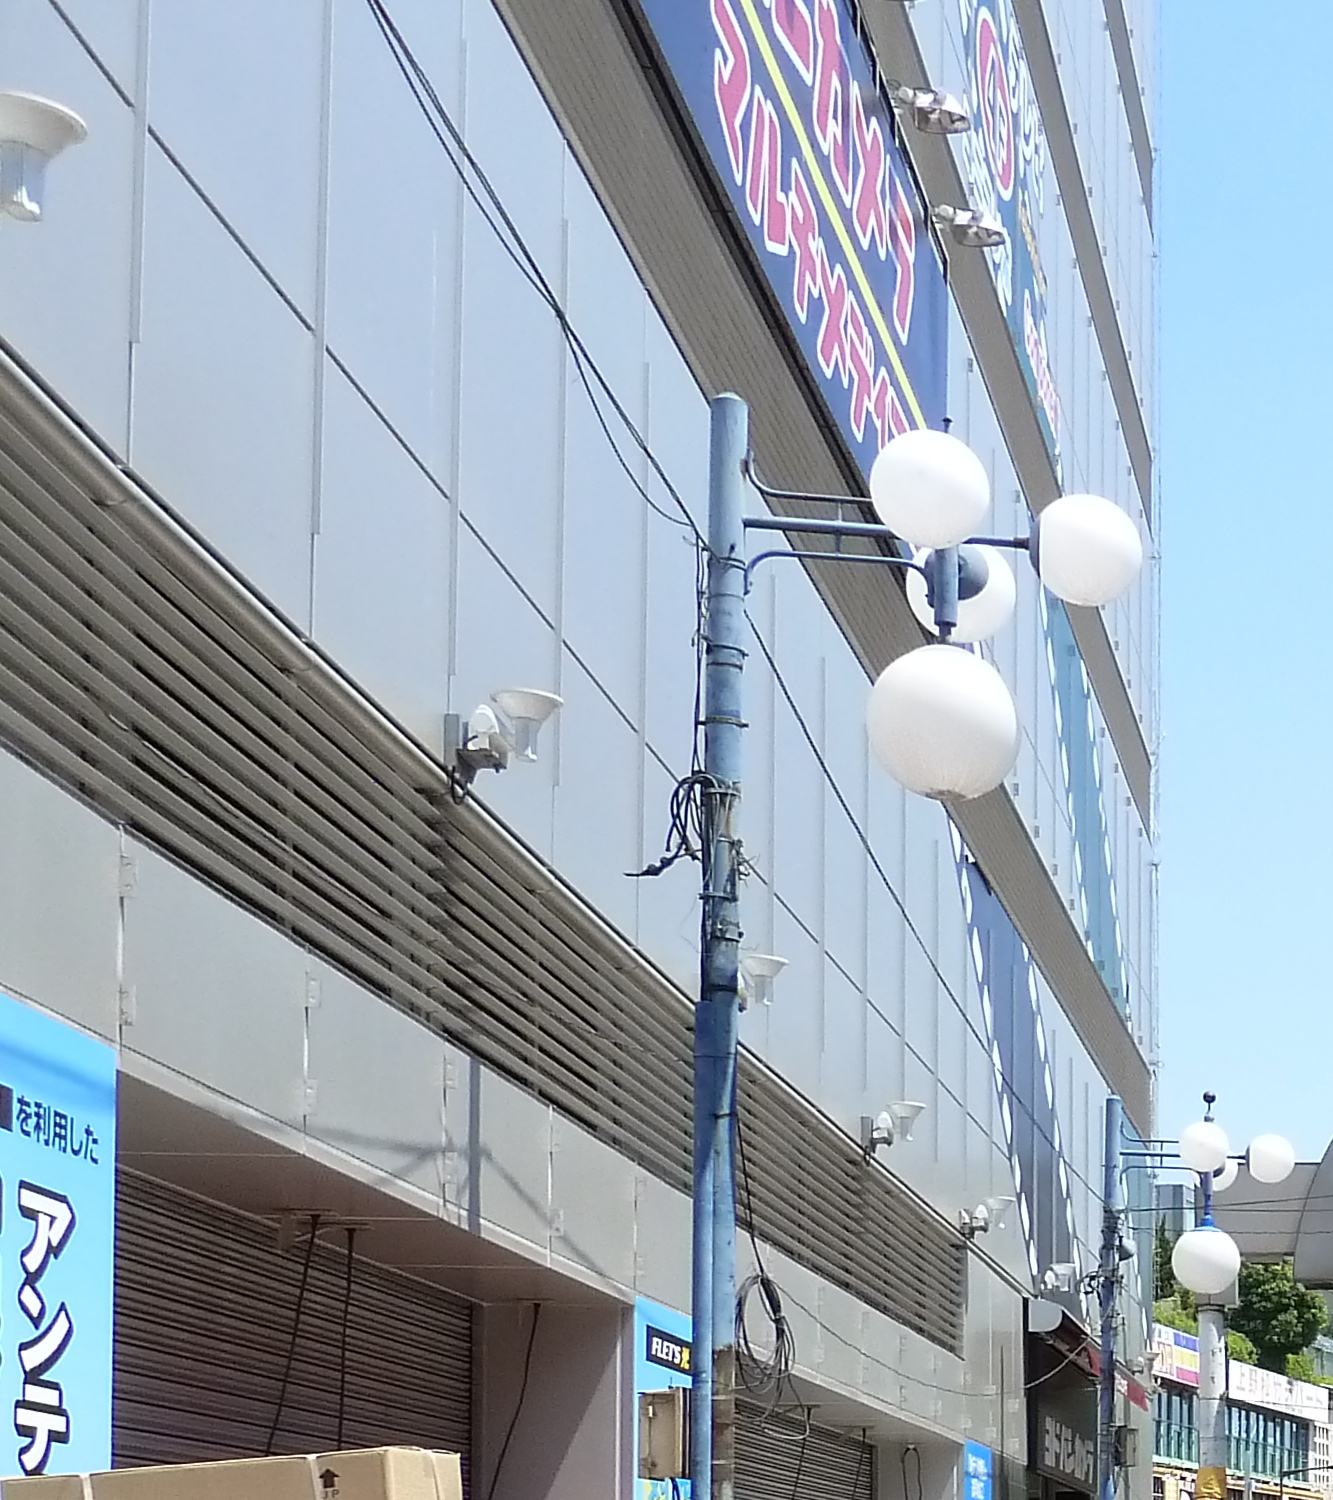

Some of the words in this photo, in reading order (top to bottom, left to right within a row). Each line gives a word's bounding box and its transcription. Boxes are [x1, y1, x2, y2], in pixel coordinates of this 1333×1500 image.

[16, 1095, 99, 1165] を利用した
